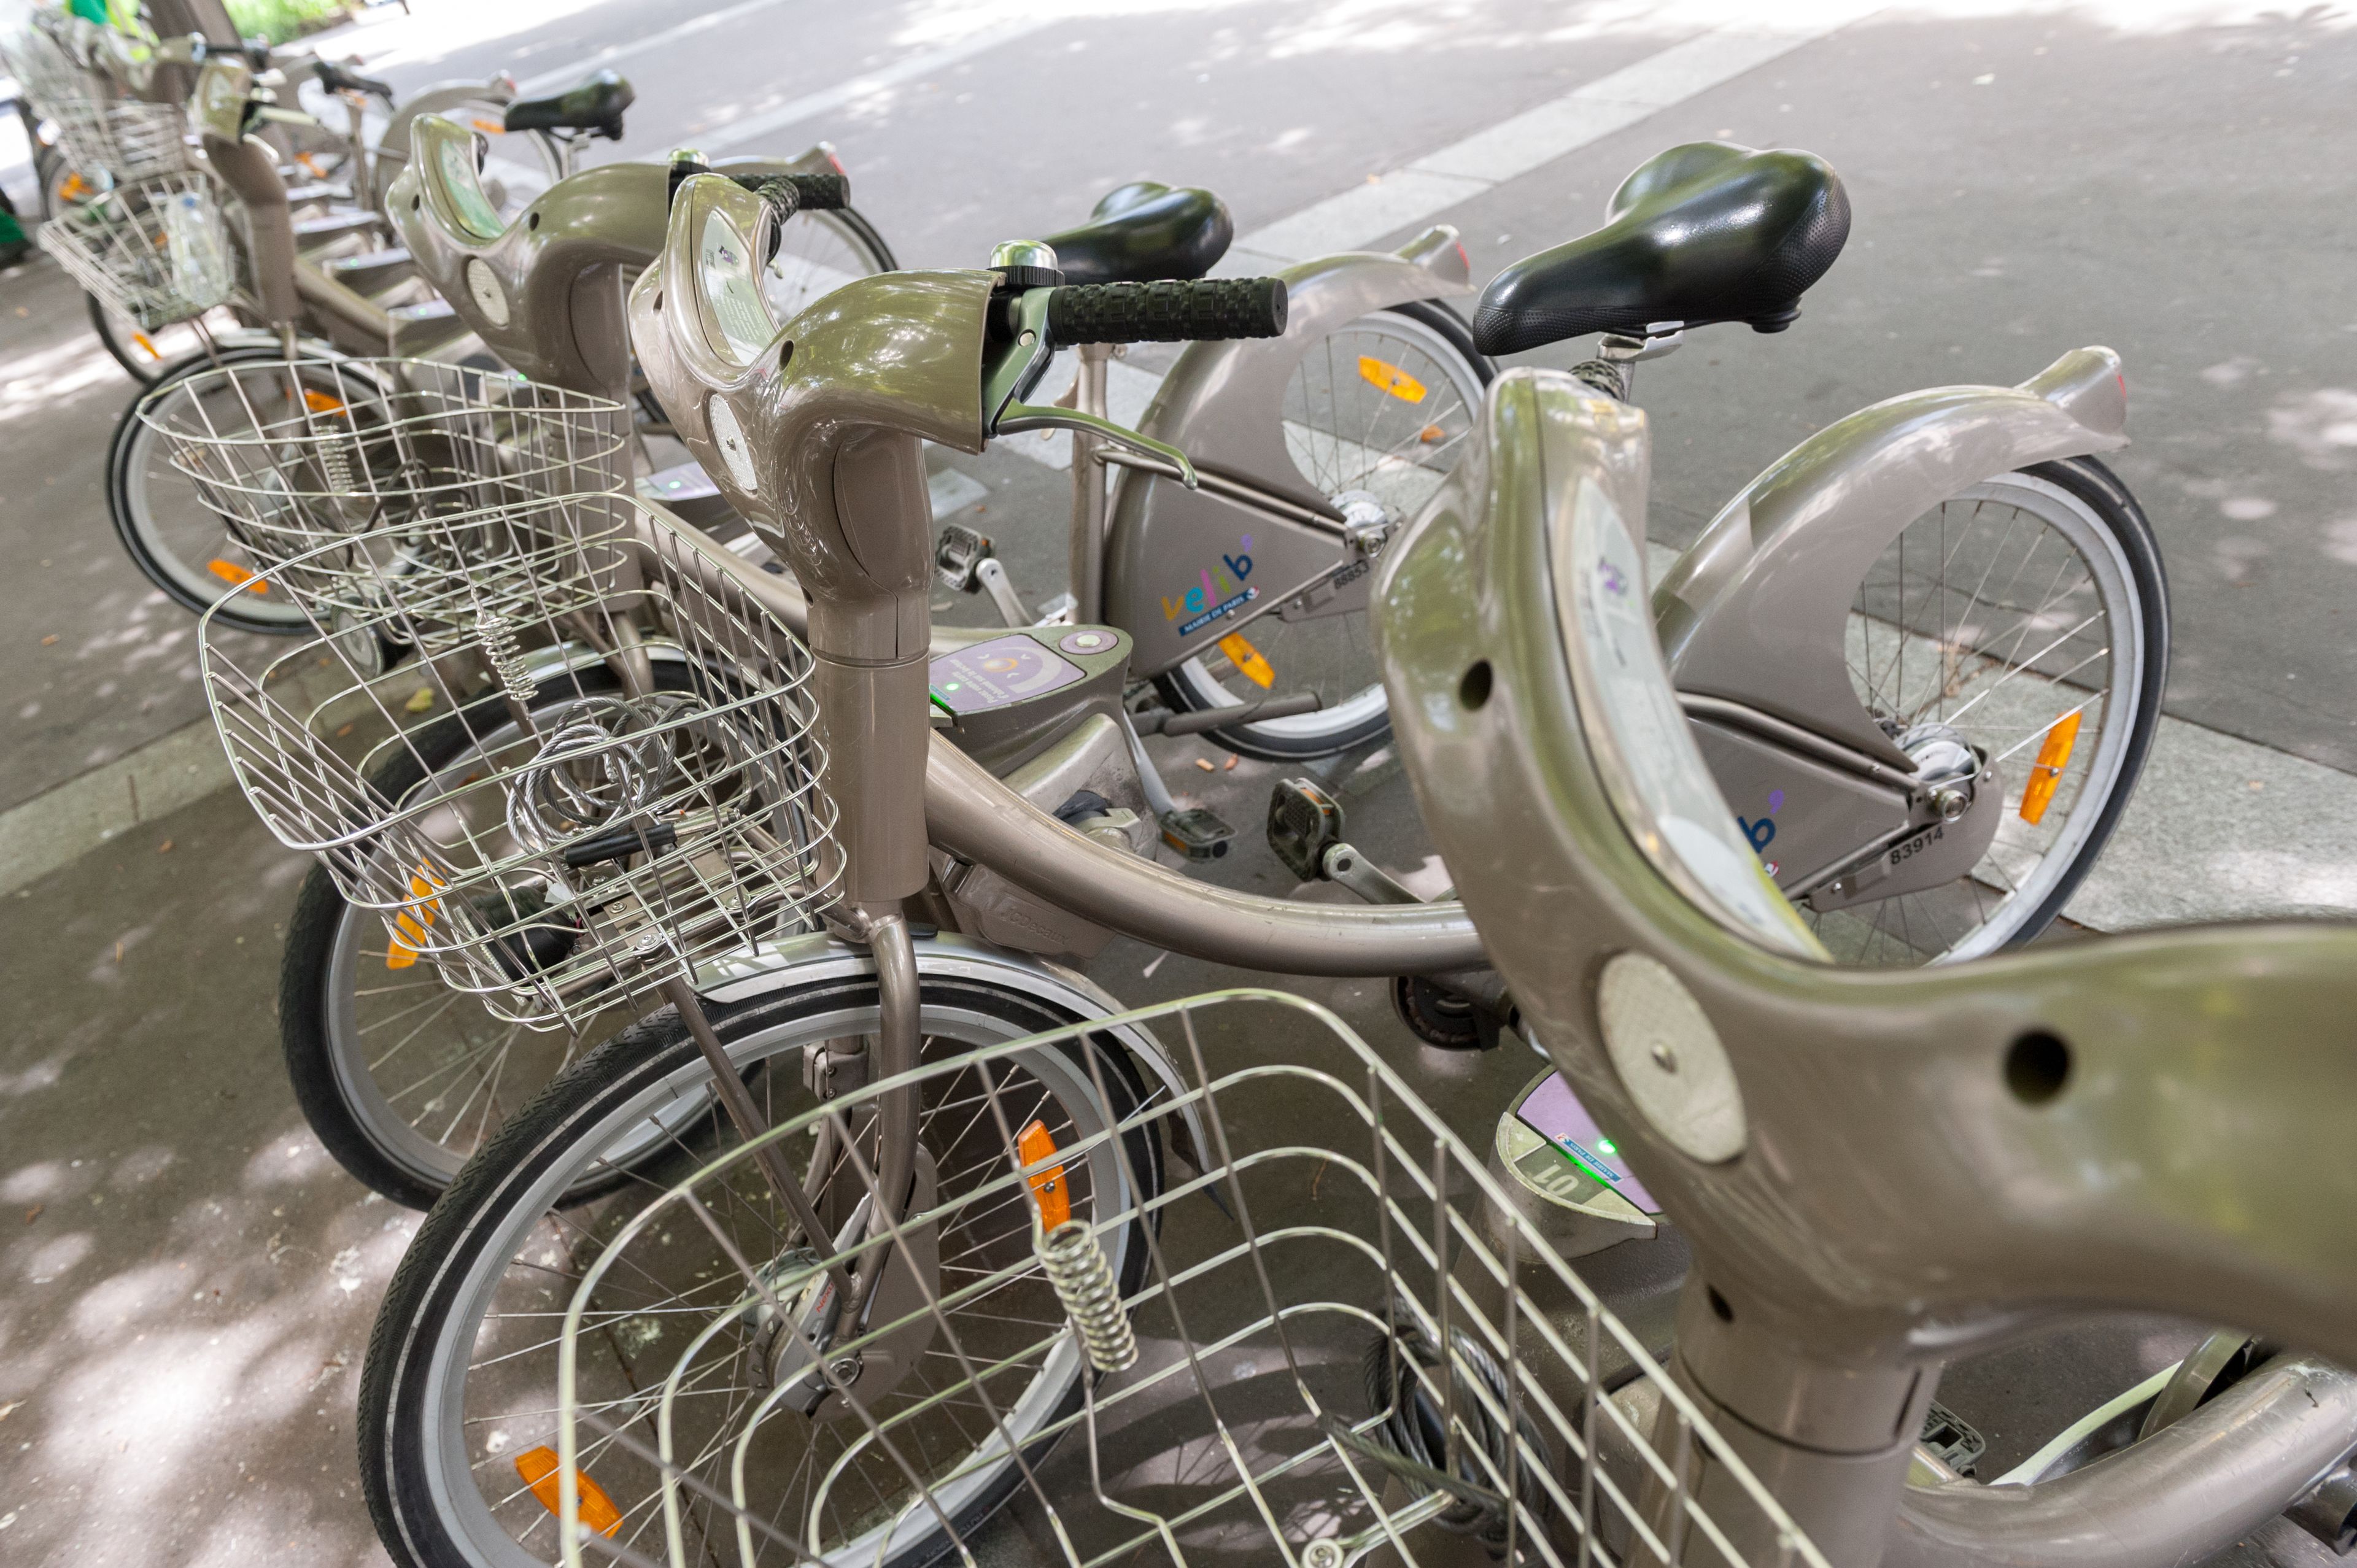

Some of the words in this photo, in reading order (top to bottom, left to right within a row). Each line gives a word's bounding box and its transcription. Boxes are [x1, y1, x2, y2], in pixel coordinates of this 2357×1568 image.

[1182, 612, 1212, 633] MAIRIE
[1209, 606, 1223, 619] DE
[1221, 594, 1245, 612] PARIS
[1890, 826, 1944, 865] 83914
[1569, 1142, 1584, 1156] PARIS
[1593, 1160, 1615, 1177] MAIRIE
